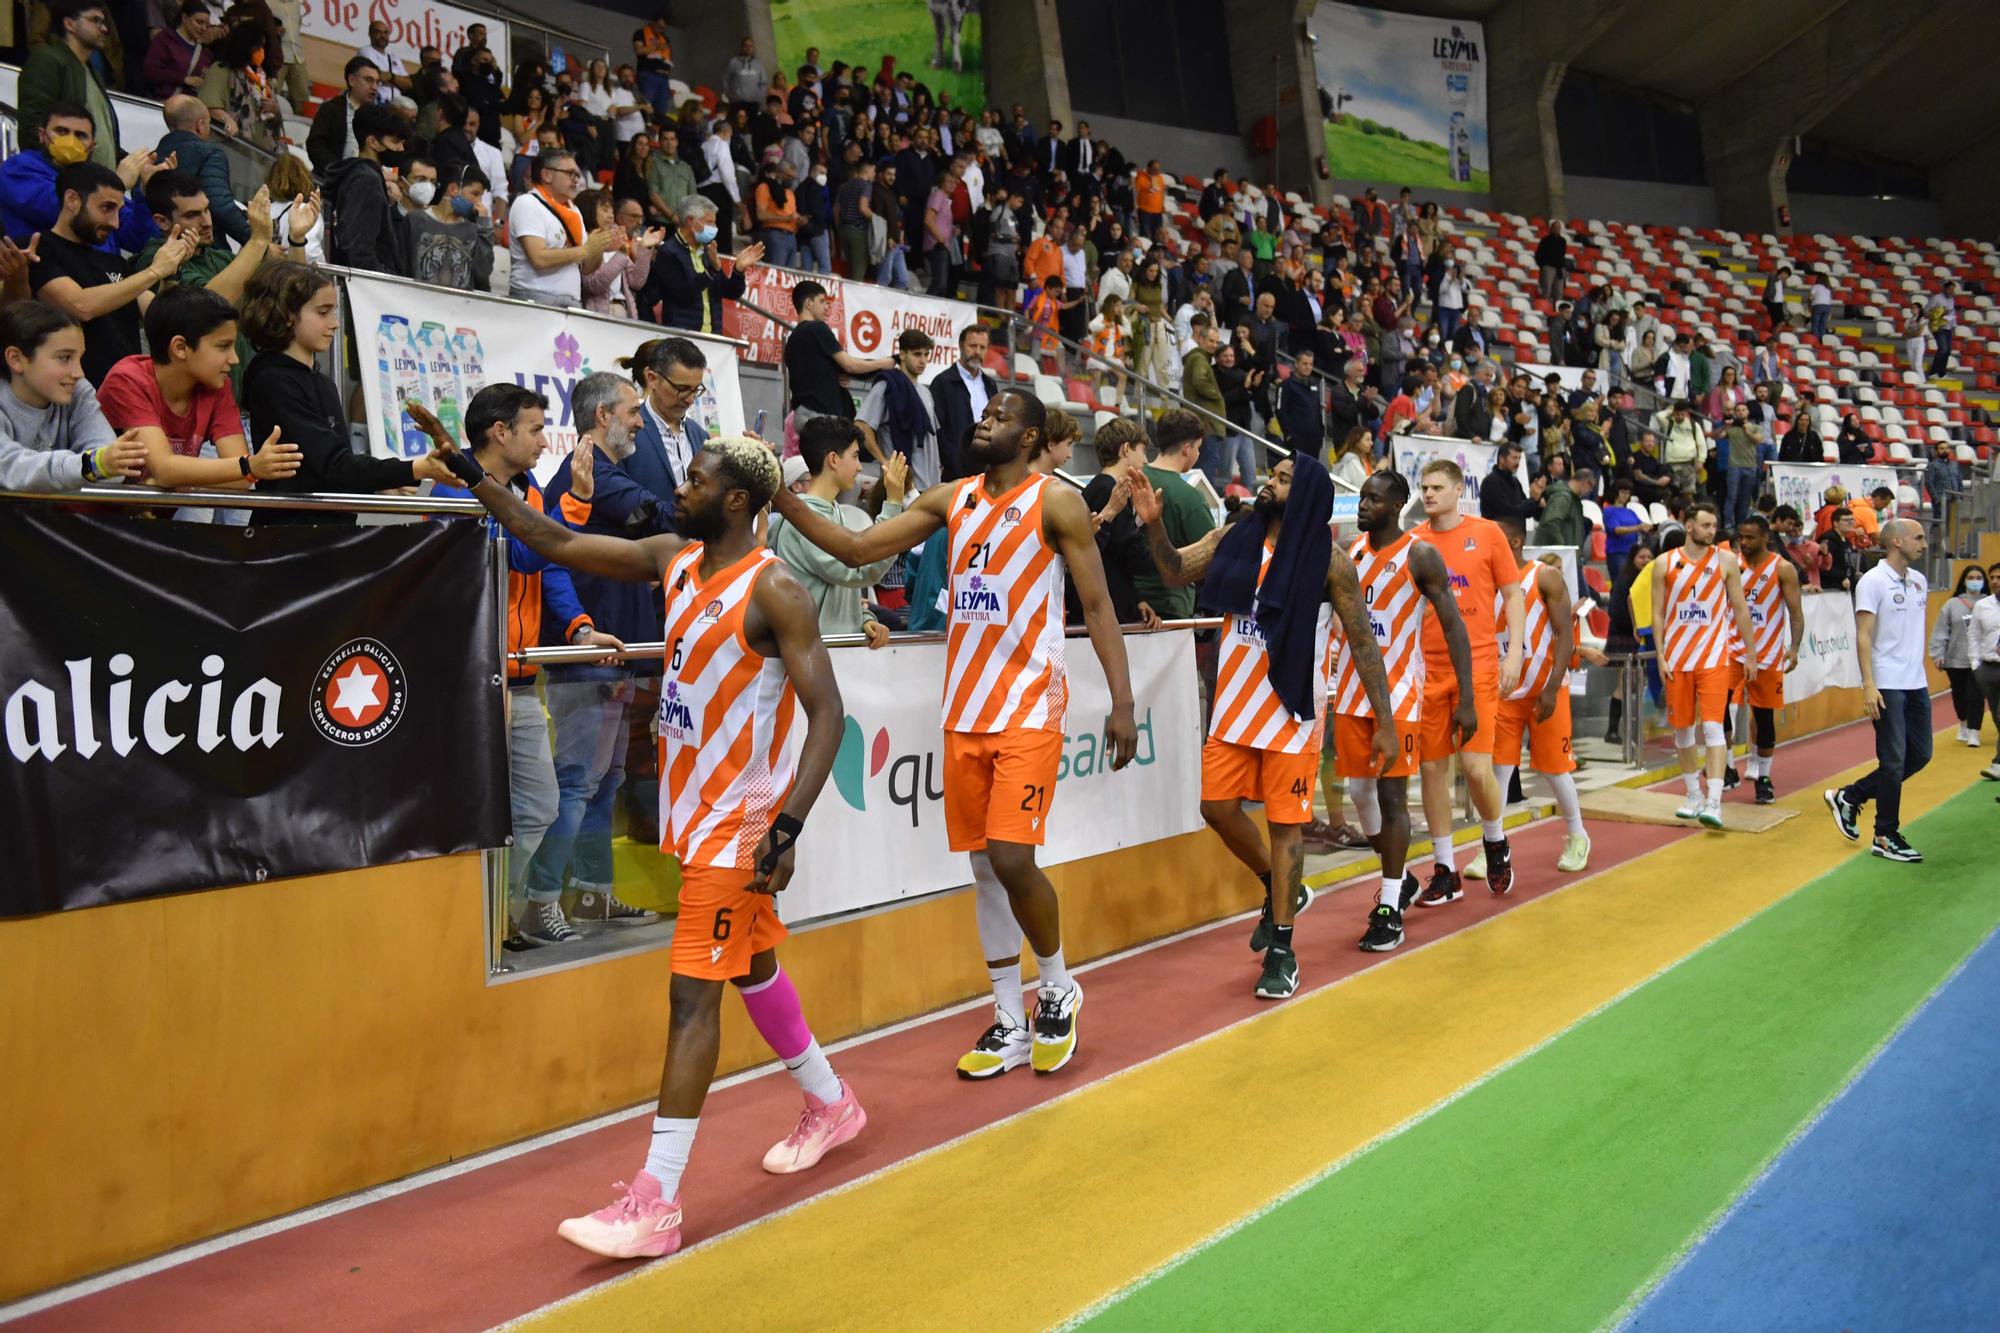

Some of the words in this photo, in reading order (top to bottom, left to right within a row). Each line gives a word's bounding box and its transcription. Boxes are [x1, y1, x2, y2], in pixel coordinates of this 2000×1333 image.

[1433, 37, 1479, 63] LEYMA
[892, 310, 900, 331] A
[394, 358, 417, 371] LEYMA
[430, 361, 452, 373] LEYMA
[463, 363, 483, 374] LEYMA
[968, 542, 991, 569] 21
[954, 591, 1000, 612] LEYMA
[1365, 585, 1374, 604] 0
[1690, 584, 1696, 599] 1
[1744, 588, 1758, 602] 25
[961, 611, 990, 621] NATURA
[1679, 609, 1707, 620] LEYMA
[322, 644, 361, 679] ESTRELLA
[364, 643, 395, 674] GALICIA
[672, 636, 684, 672] 6
[5, 653, 284, 764] alicia
[314, 700, 361, 741] CERVECEROS
[364, 716, 393, 740] DESDE
[390, 691, 402, 717] 1906
[659, 697, 694, 731] EYMA
[1405, 733, 1413, 753] 0
[1562, 736, 1570, 754] 2
[1291, 775, 1308, 799] 44
[1021, 784, 1045, 812] 21
[713, 907, 733, 941] 6
